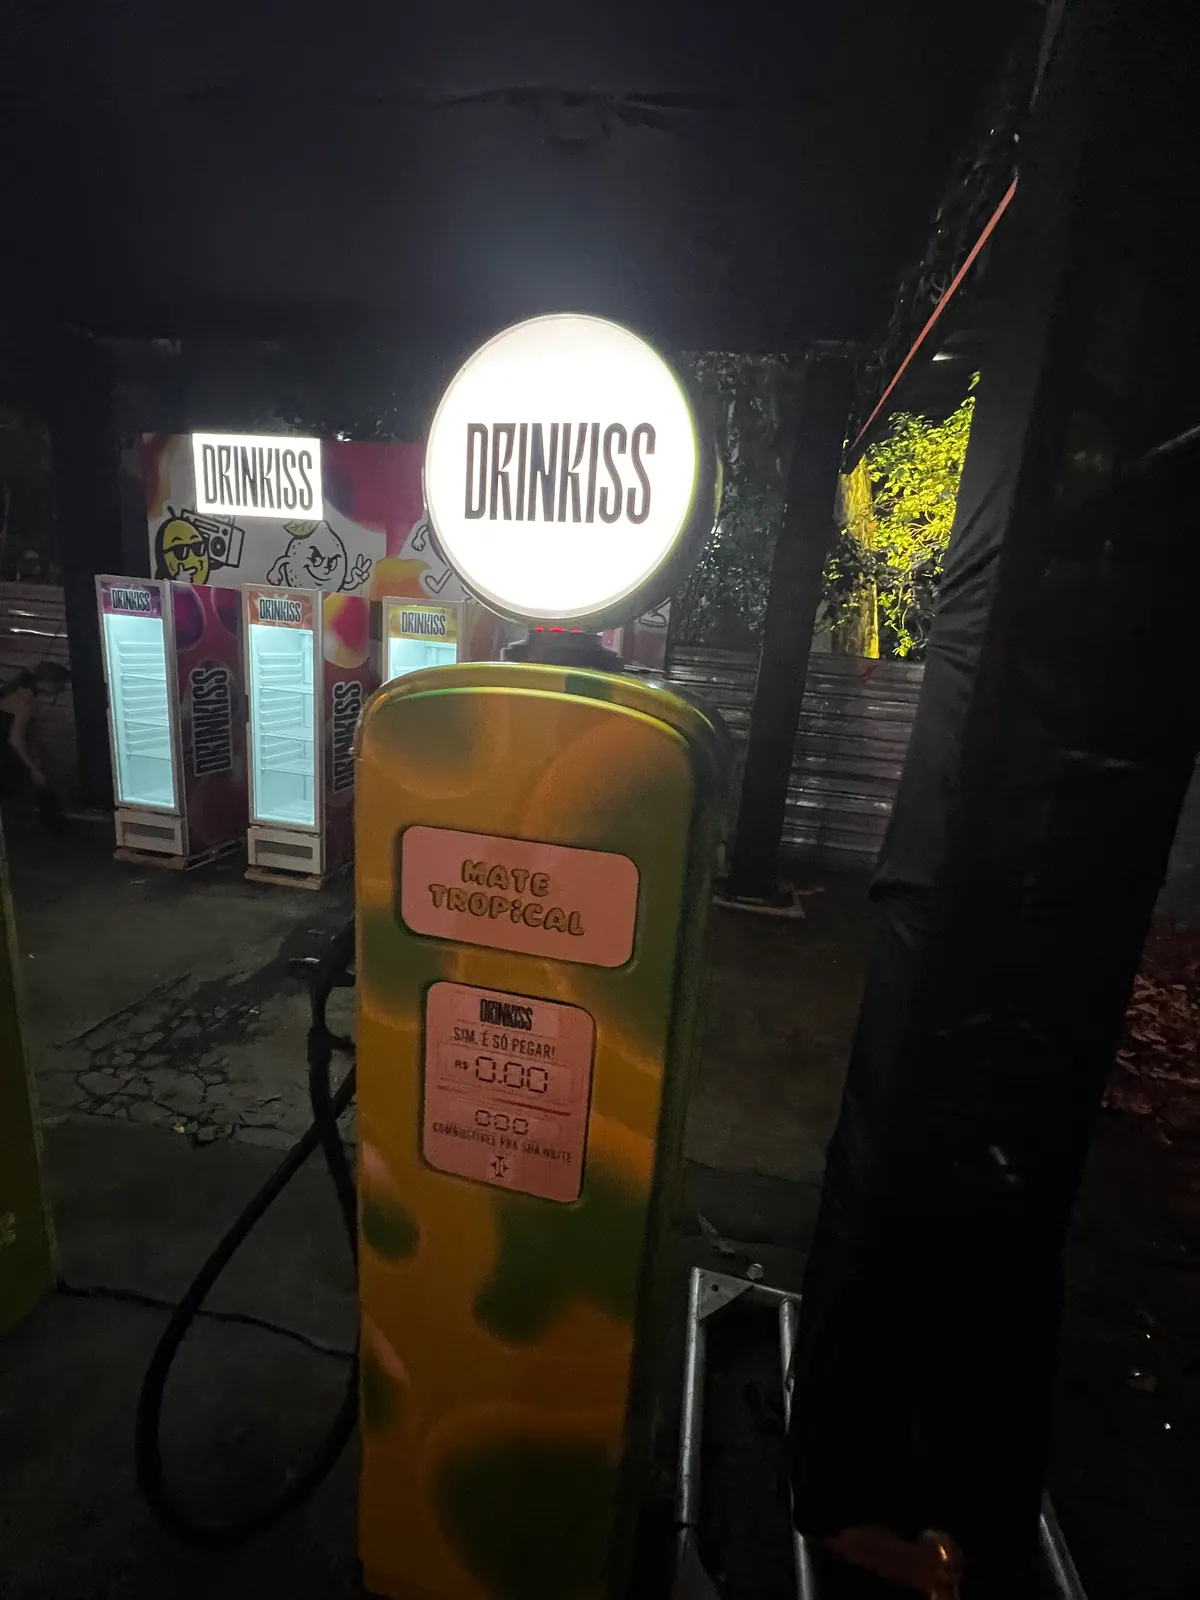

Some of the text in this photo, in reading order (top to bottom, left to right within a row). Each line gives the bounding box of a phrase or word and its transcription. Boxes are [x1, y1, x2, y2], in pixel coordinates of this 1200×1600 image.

[202, 443, 313, 510] DRINKISS
[464, 422, 656, 524] DRINKISS
[111, 588, 151, 612] DRINKISS
[258, 598, 302, 623] DRINKISS
[401, 611, 446, 636] DRINKISS
[191, 670, 232, 775] DRINKISS
[461, 859, 551, 897] MATE
[480, 999, 533, 1031] DRINKISS
[480, 1030, 489, 1047] É
[492, 1033, 509, 1050] SÓ
[512, 1038, 556, 1060] PEGAR!
[475, 1056, 548, 1093] 0.00
